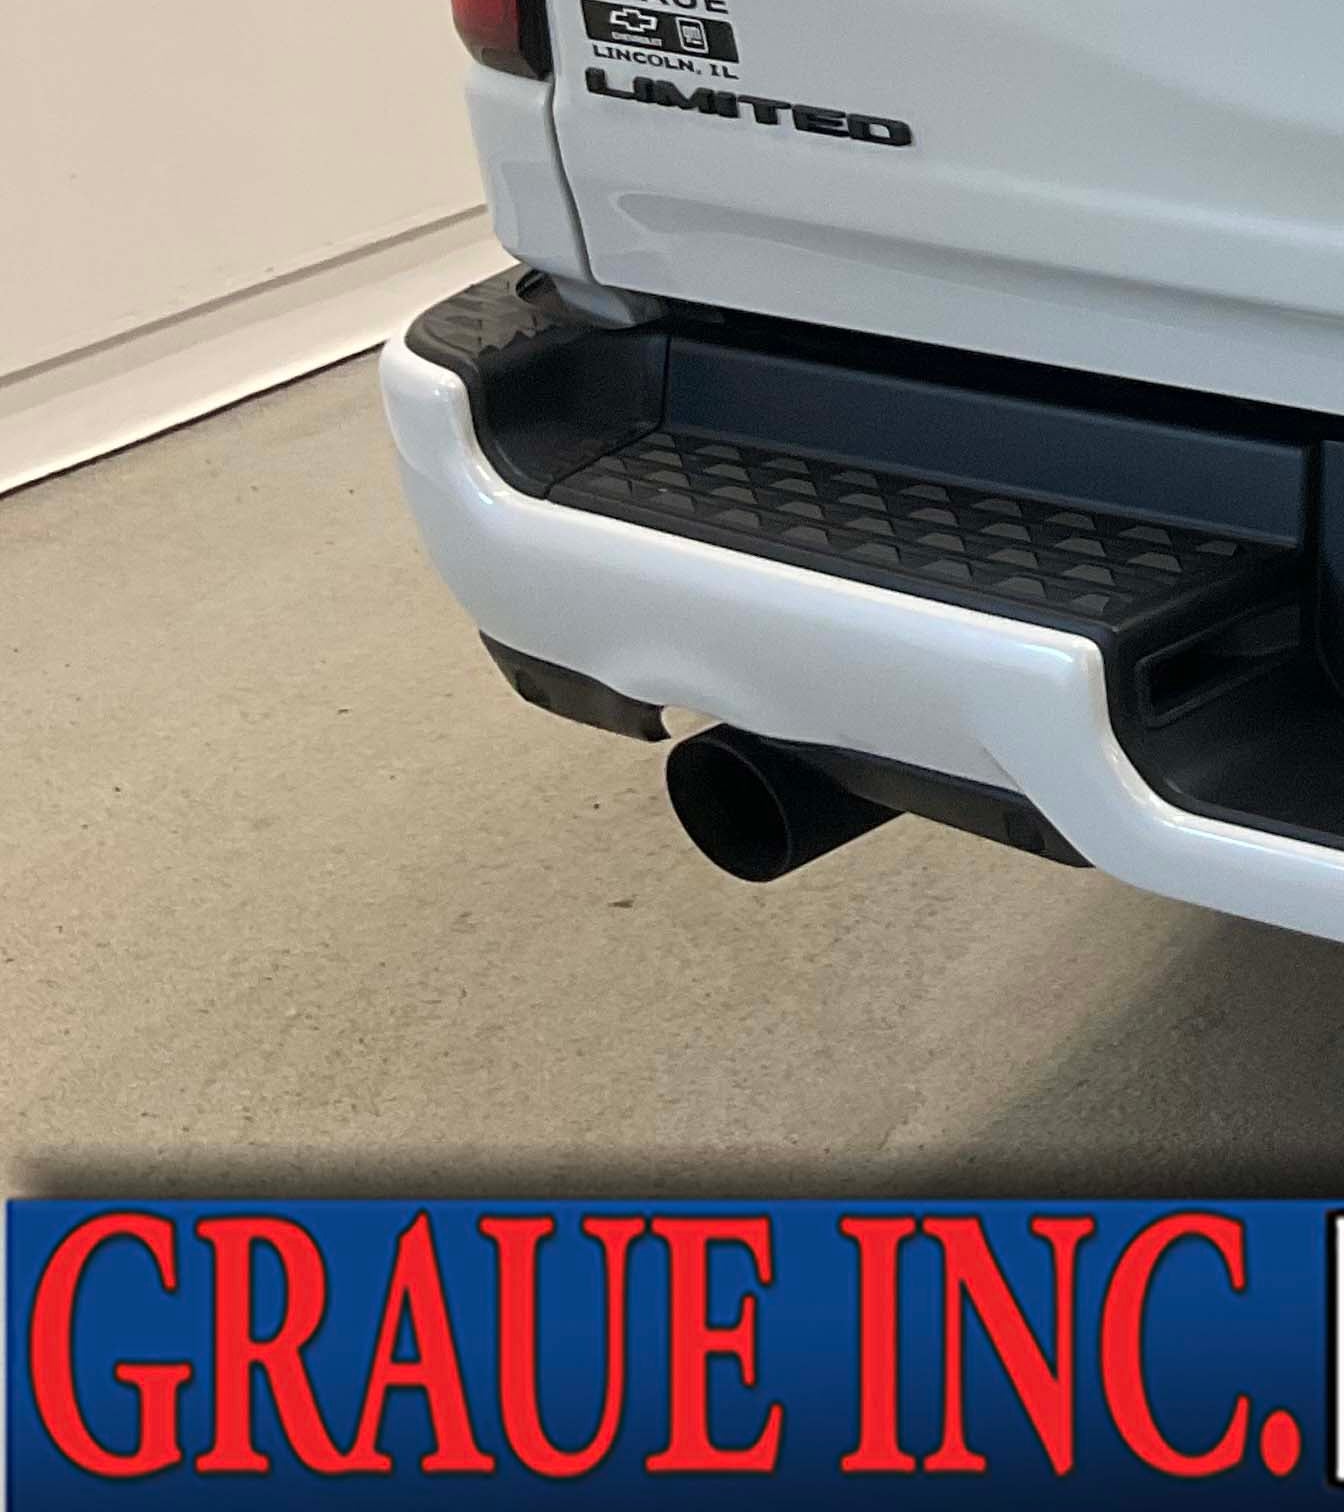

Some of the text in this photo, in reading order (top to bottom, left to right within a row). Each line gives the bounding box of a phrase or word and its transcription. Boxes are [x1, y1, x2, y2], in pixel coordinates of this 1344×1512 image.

[592, 44, 740, 81] LINCOLN, IL
[584, 66, 914, 148] LIMITED
